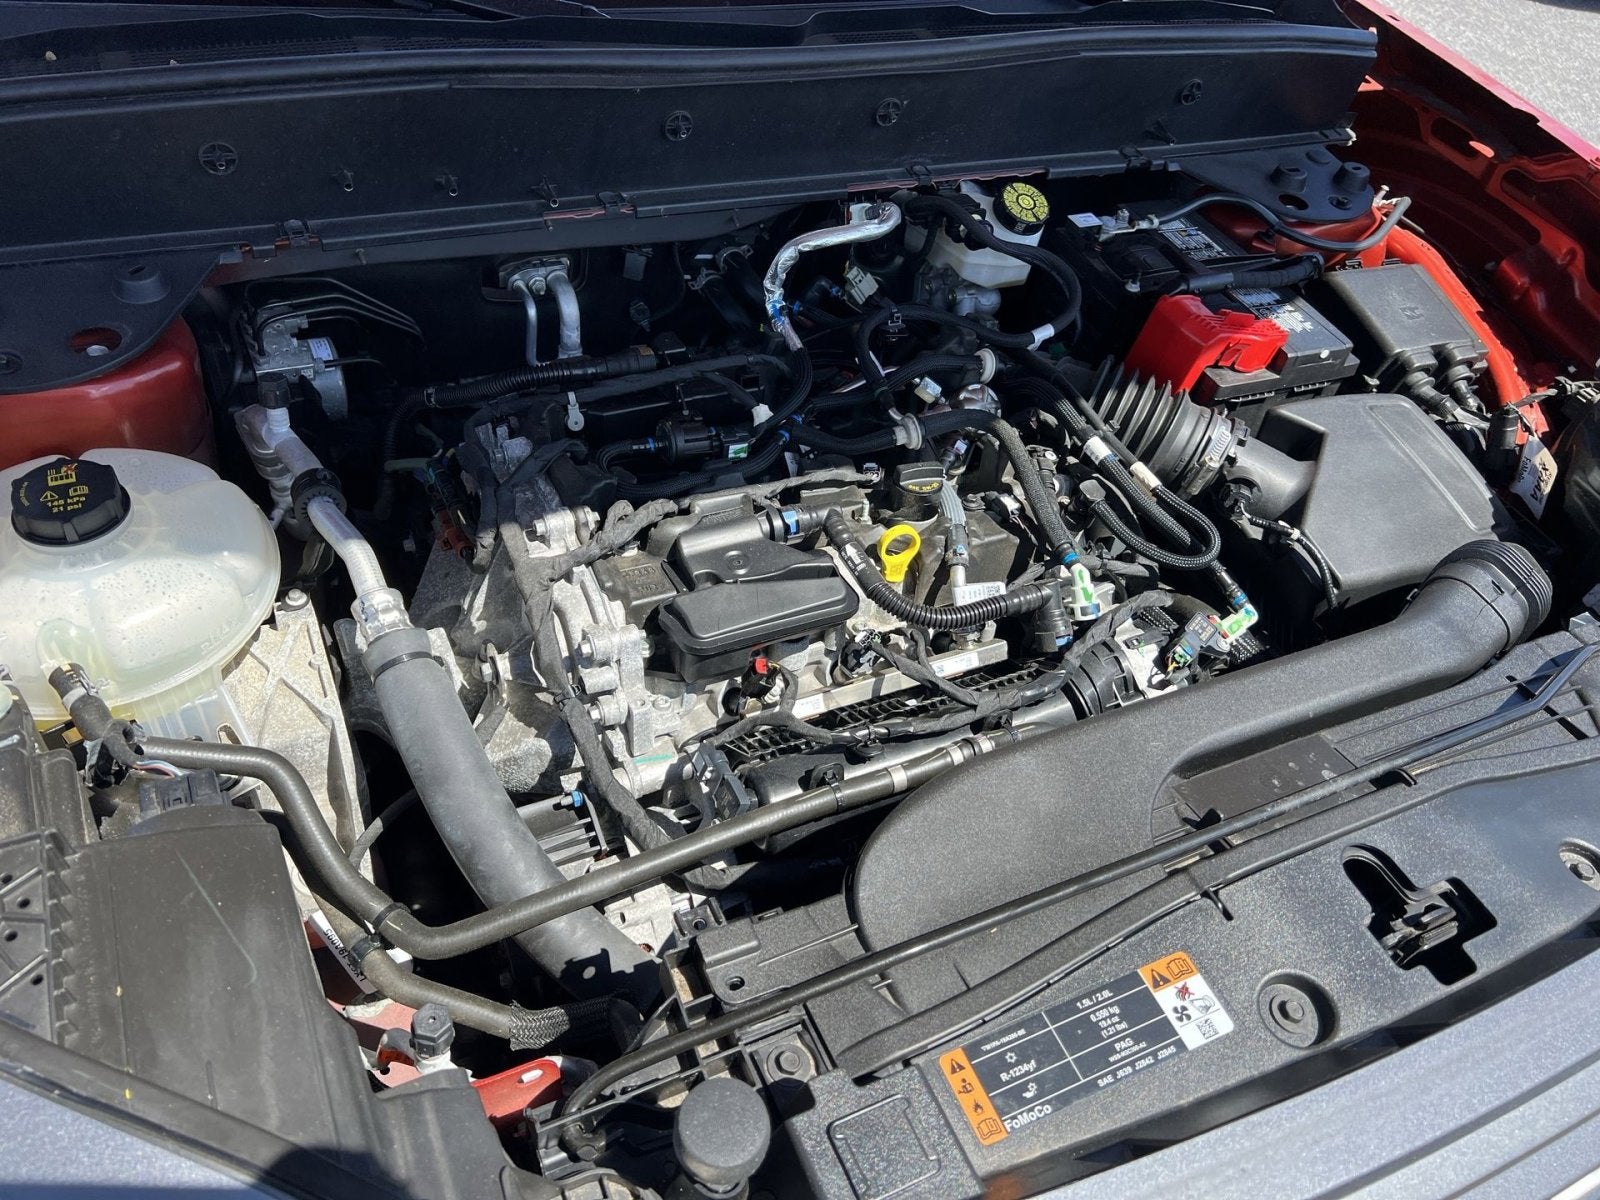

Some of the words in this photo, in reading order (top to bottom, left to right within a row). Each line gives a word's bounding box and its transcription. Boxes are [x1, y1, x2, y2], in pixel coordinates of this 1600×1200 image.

[46, 499, 65, 507] 145
[67, 496, 86, 504] kPa
[67, 503, 82, 511] psi
[1076, 996, 1092, 1010] 1.5L
[1095, 989, 1114, 1002] 2.0L
[1090, 1008, 1109, 1023] 0.550
[1108, 1005, 1120, 1017] kg
[1098, 1018, 1111, 1029] 19.4
[1110, 1015, 1120, 1024] oz
[1101, 1026, 1116, 1039] (1.21
[1115, 1021, 1129, 1034] lbs)
[1114, 1037, 1135, 1052] PAG
[999, 1059, 1037, 1082] R-1234yf
[1096, 1074, 1115, 1087] SAE
[1116, 1066, 1133, 1079] J639
[1134, 1056, 1155, 1070] J2842
[1157, 1046, 1177, 1060] J2845
[1003, 1104, 1052, 1132] FoMoCo
